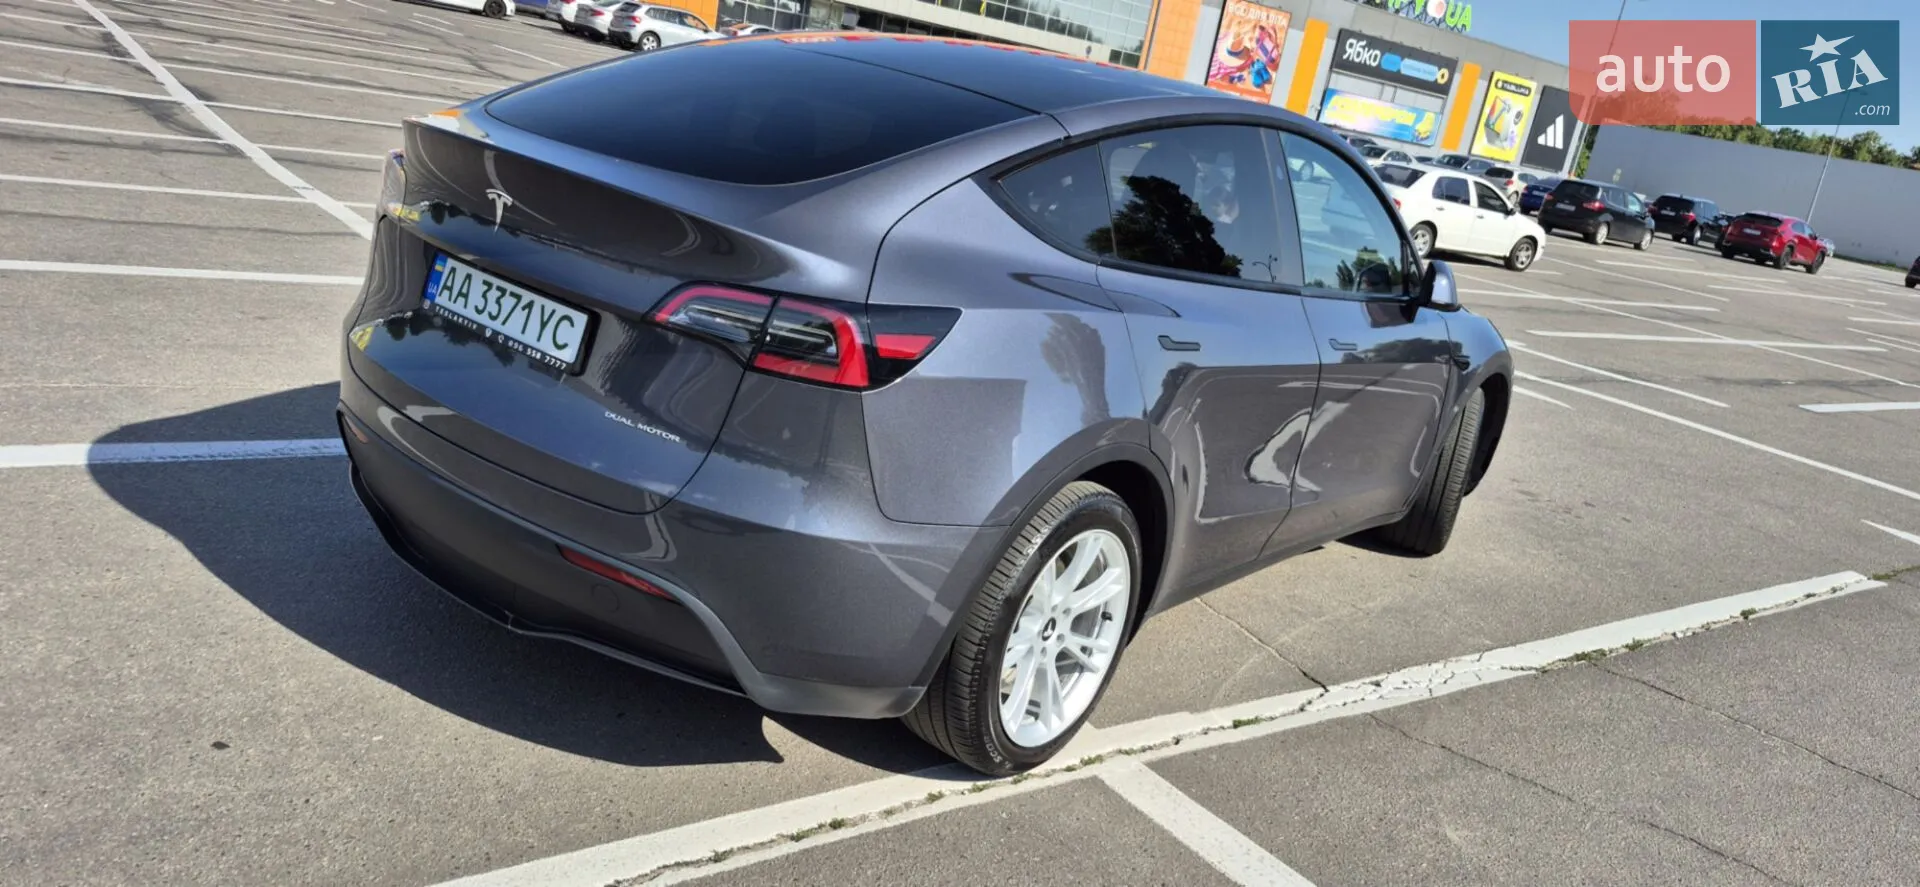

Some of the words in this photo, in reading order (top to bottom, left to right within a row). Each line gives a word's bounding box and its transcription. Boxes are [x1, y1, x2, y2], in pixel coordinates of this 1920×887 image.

[1343, 38, 1381, 67] Ябко
[427, 282, 437, 294] UA
[544, 355, 567, 370] 7777
[604, 408, 635, 428] DUAL
[637, 423, 681, 442] MOTOR
